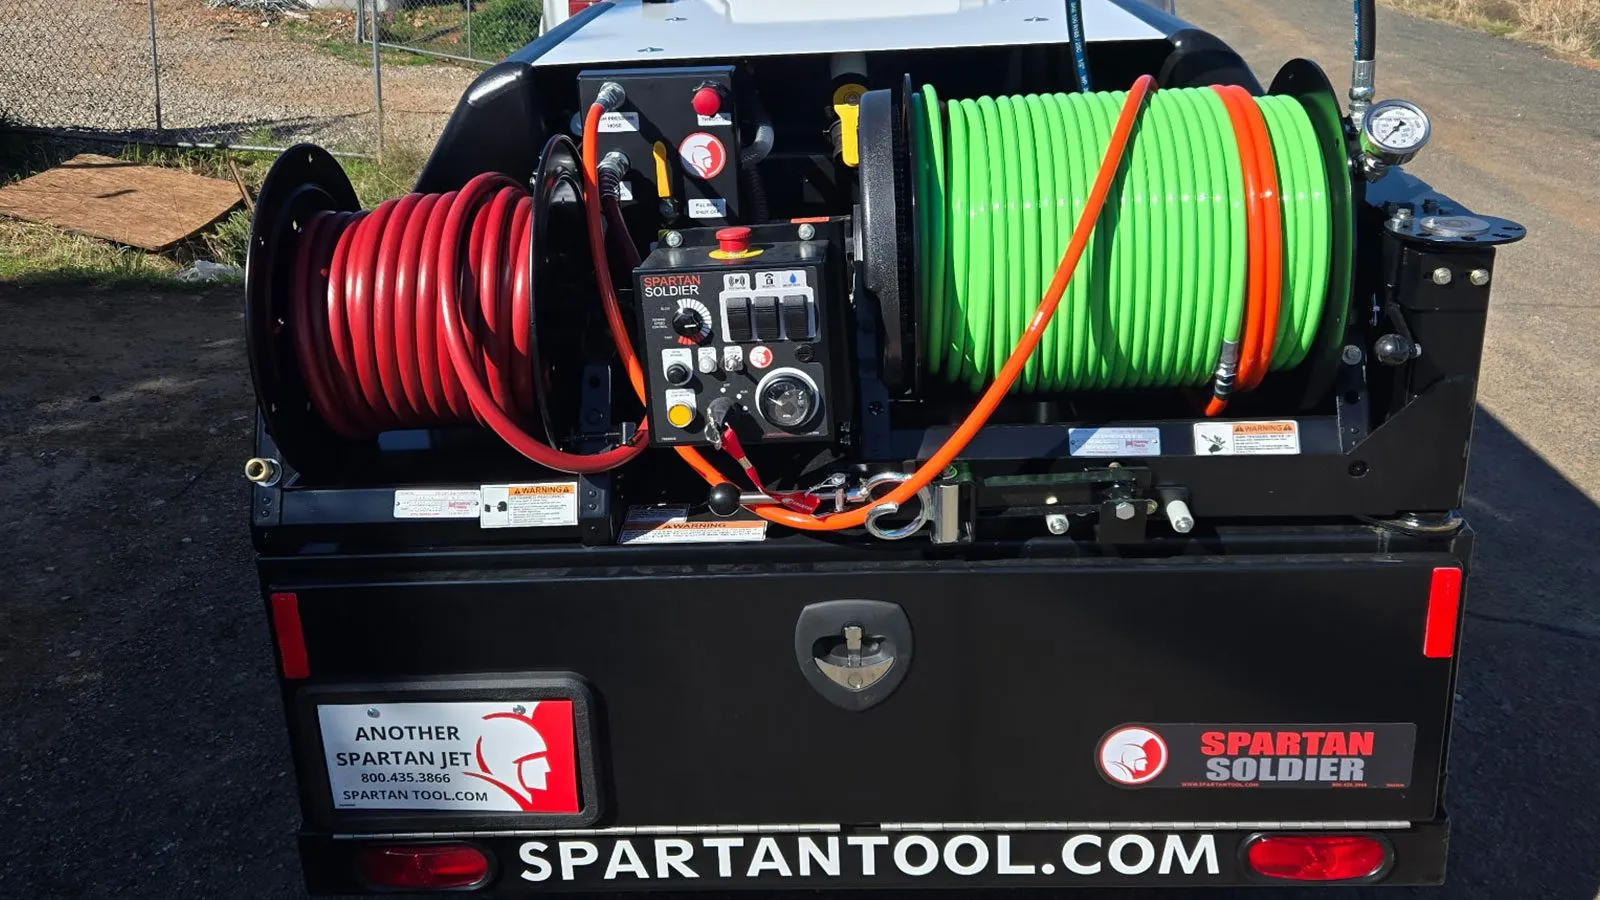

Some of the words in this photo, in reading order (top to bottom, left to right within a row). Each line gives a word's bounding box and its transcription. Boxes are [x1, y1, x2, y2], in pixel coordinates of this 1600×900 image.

[644, 275, 701, 288] SPARTAN
[645, 285, 699, 297] SOLDIER
[1244, 424, 1283, 433] WARNING
[522, 486, 562, 495] WARNING
[355, 726, 460, 742] ANOTHER
[1201, 731, 1375, 756] SPARTAN
[336, 750, 435, 767] SPARTAN
[440, 751, 472, 769] JET
[1206, 757, 1365, 781] SOLDIER
[361, 772, 451, 784] 800.435.3866
[343, 790, 409, 801] SPARTAN
[412, 790, 488, 802] TOOL.COM
[519, 834, 1220, 882] SPARTANTOOL.COM
